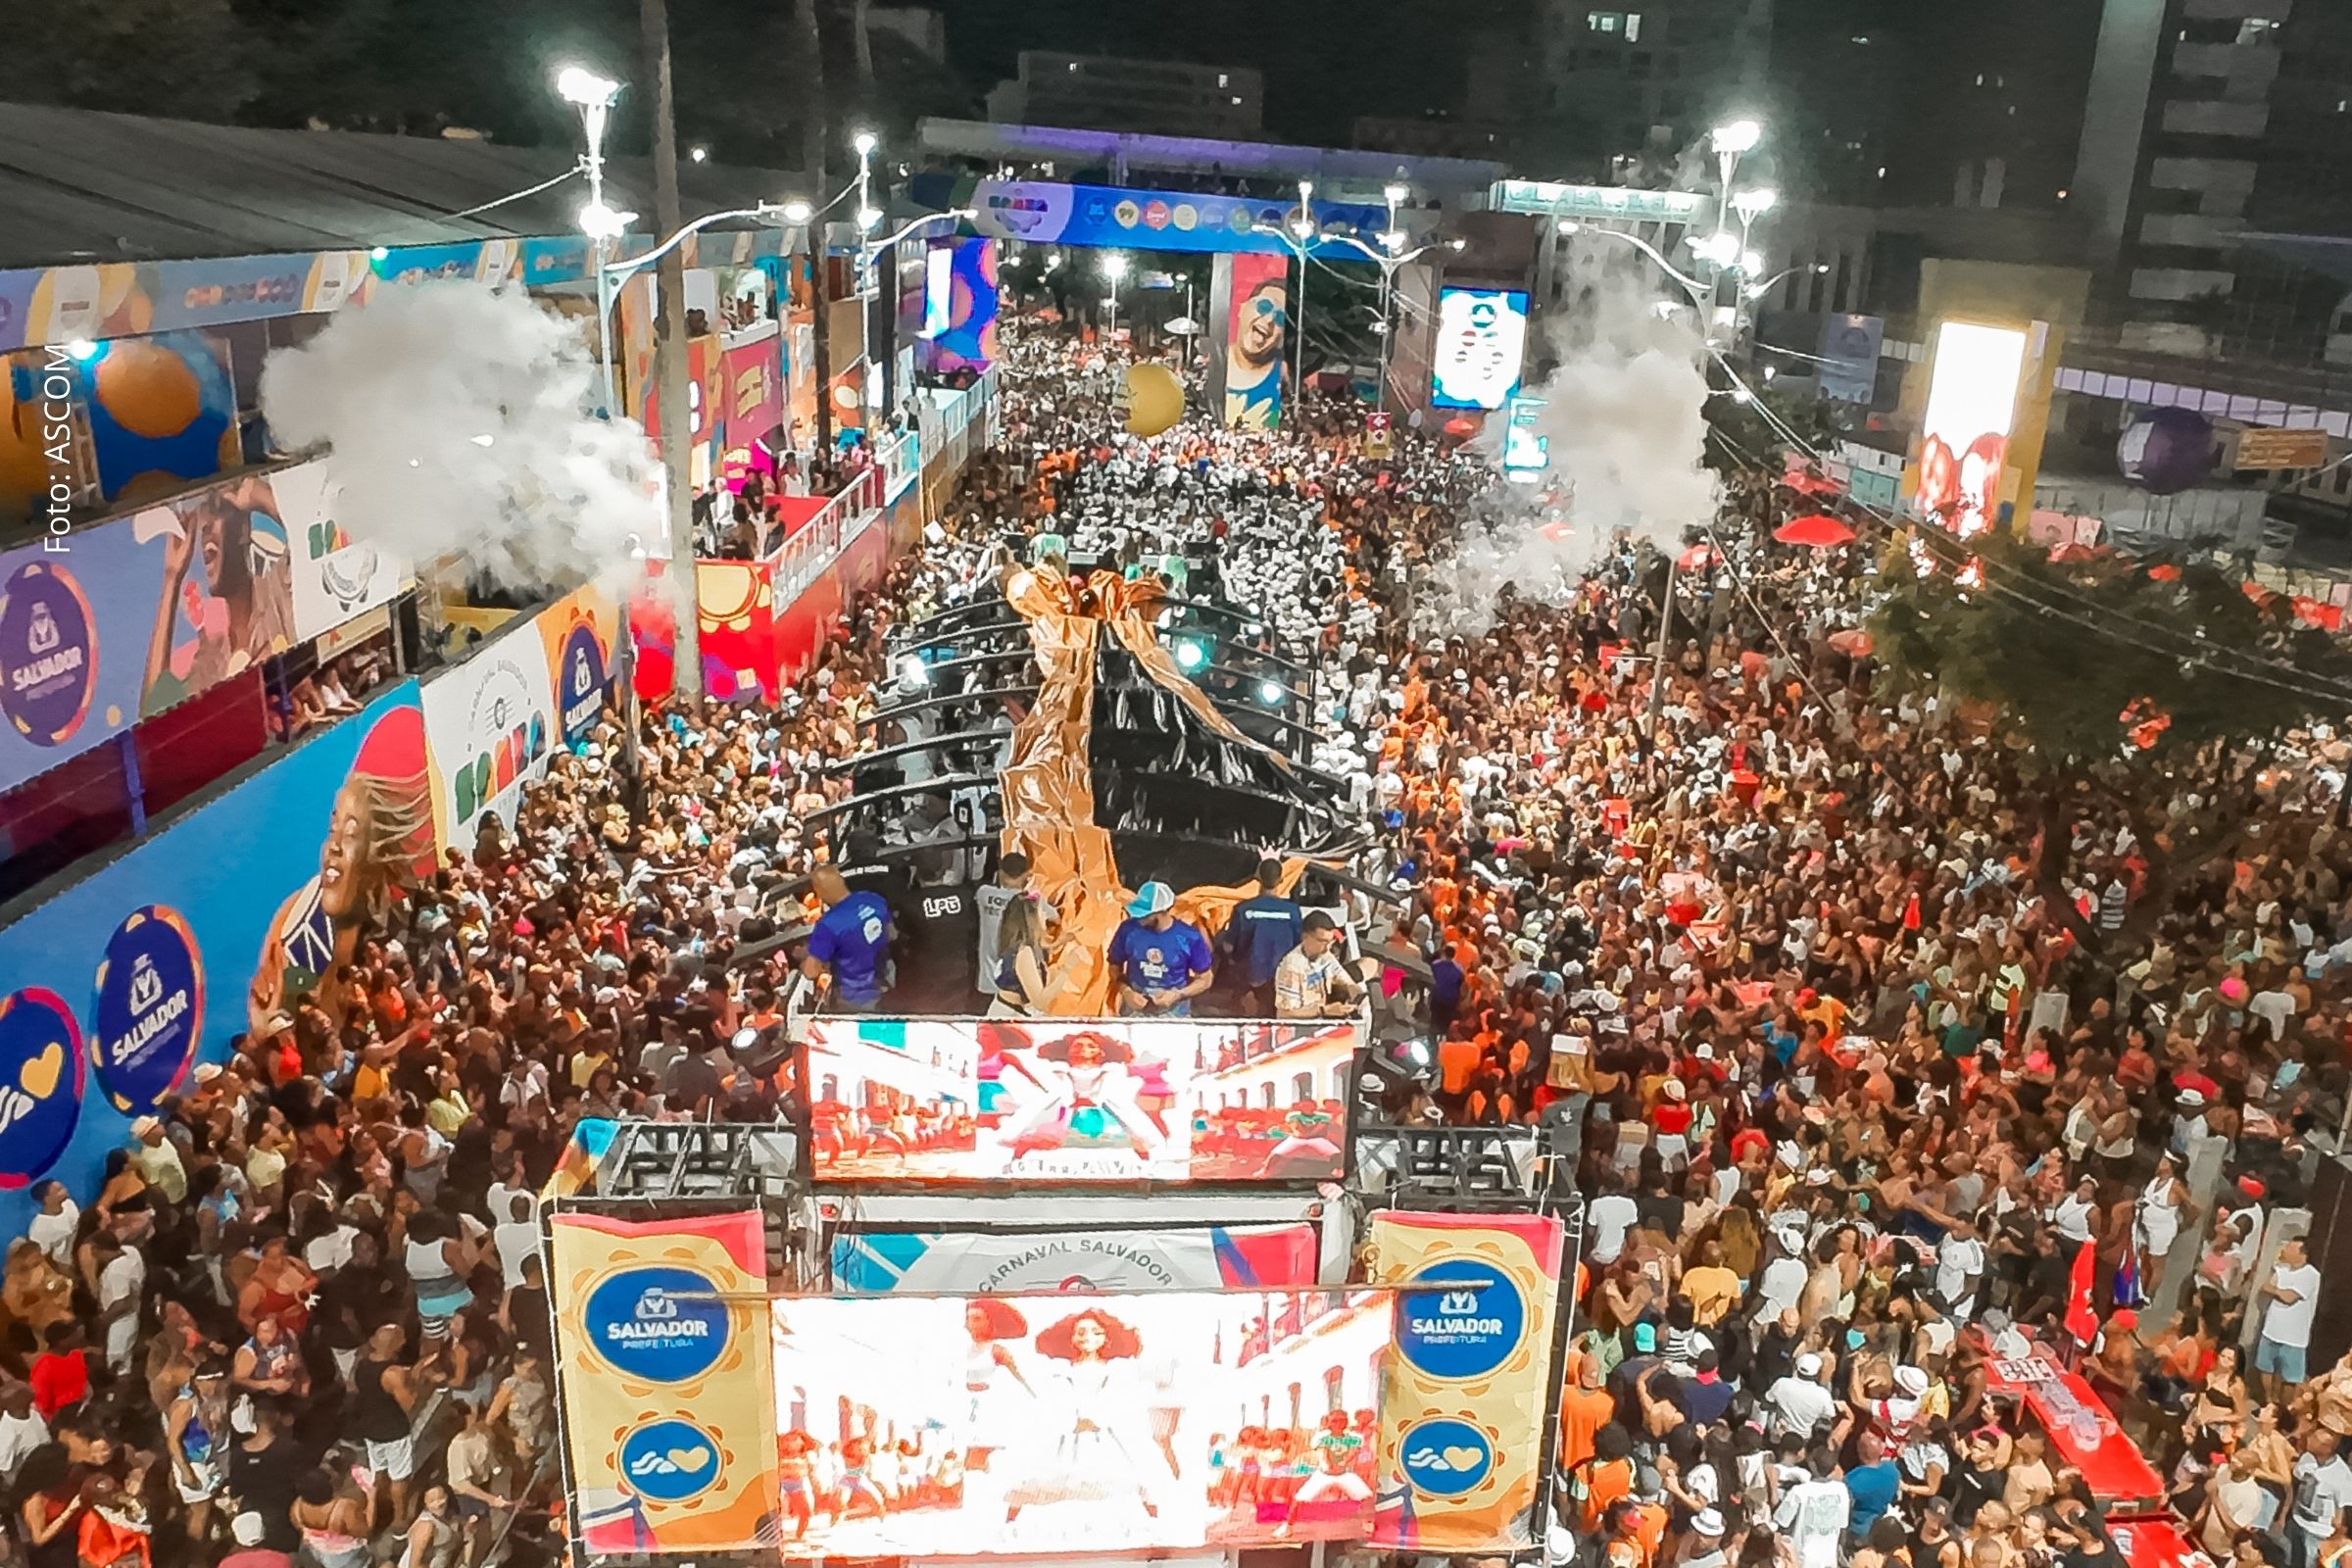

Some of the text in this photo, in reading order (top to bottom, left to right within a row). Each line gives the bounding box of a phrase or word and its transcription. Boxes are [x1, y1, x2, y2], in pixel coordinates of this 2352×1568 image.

[12, 645, 83, 691] SALVADOR
[112, 989, 188, 1066] SALVADOR
[978, 1239, 1173, 1293] CARNAVAL SALVADOR
[608, 1319, 709, 1340] SALVADOR
[1411, 1318, 1503, 1335] SALVADOR
